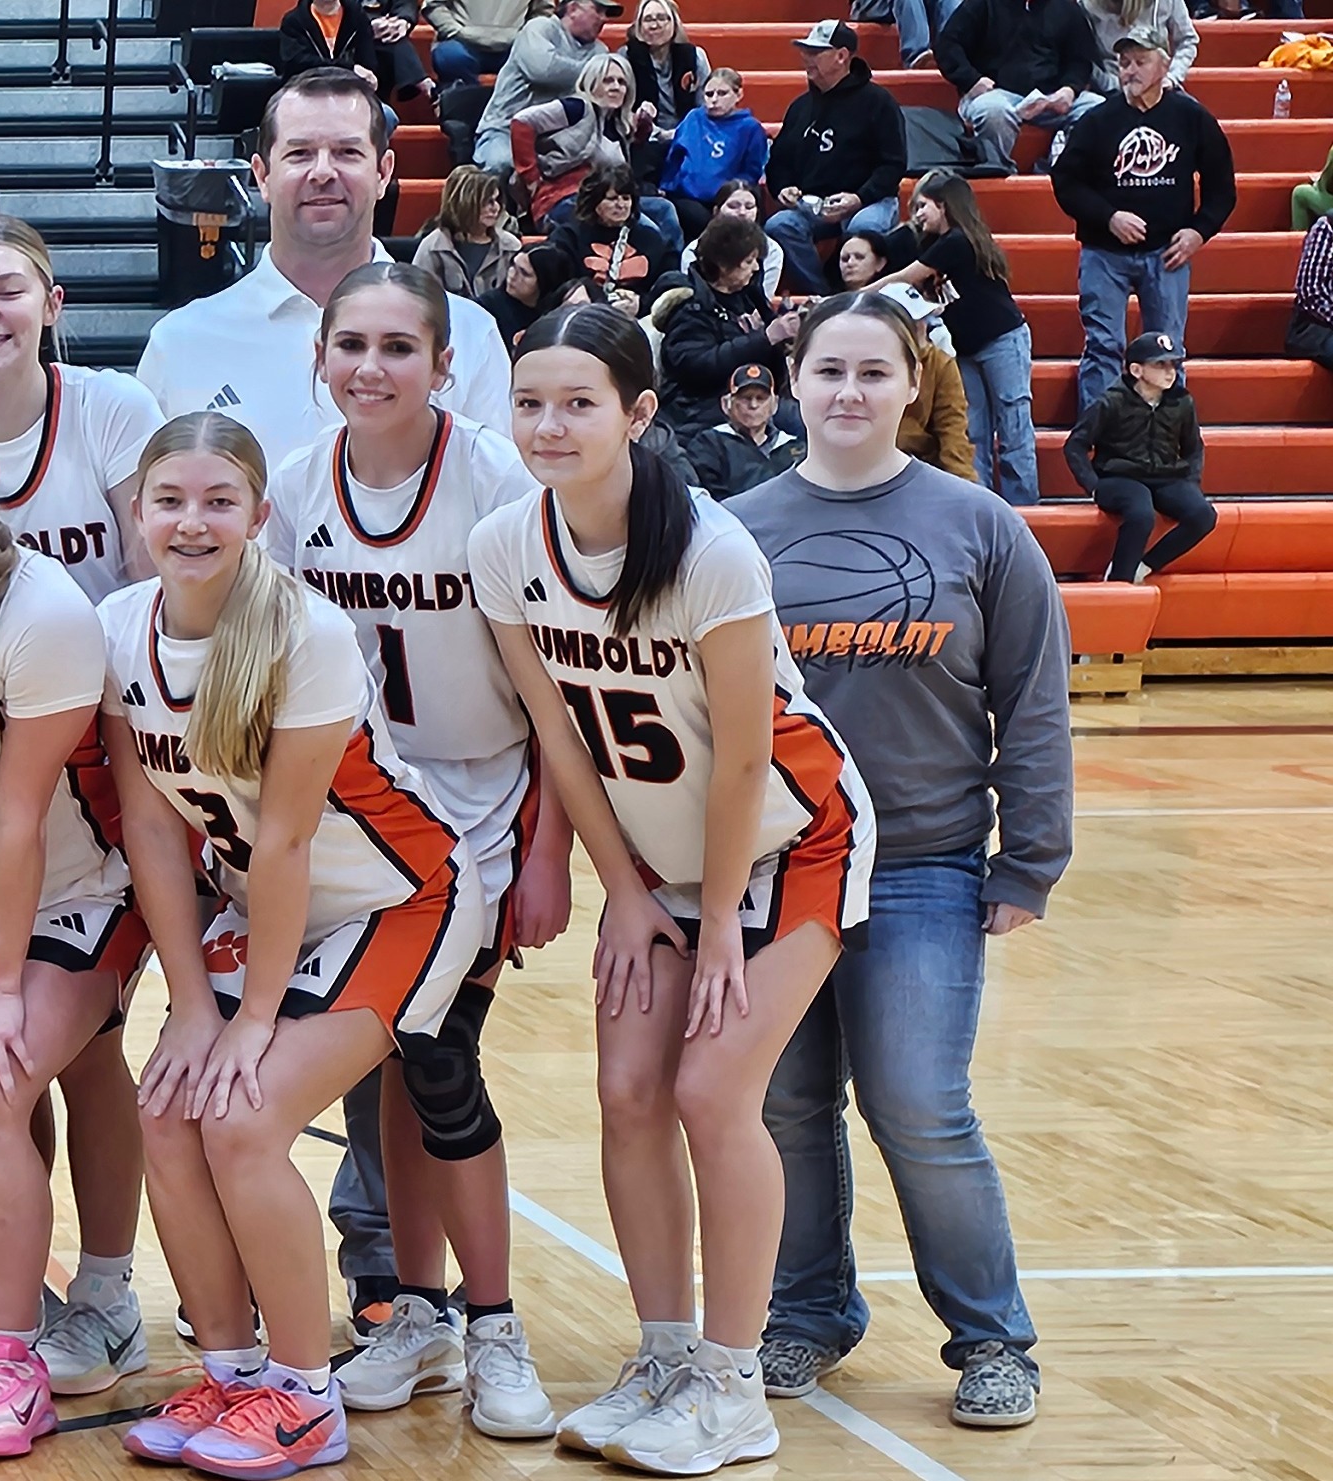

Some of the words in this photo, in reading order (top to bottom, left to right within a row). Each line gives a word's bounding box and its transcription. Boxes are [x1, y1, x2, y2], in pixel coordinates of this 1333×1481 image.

[375, 623, 416, 727] 1
[531, 623, 692, 678] UMBOLDT
[783, 621, 954, 658] MBOLDT
[557, 680, 686, 784] 15
[175, 786, 254, 874] 3
